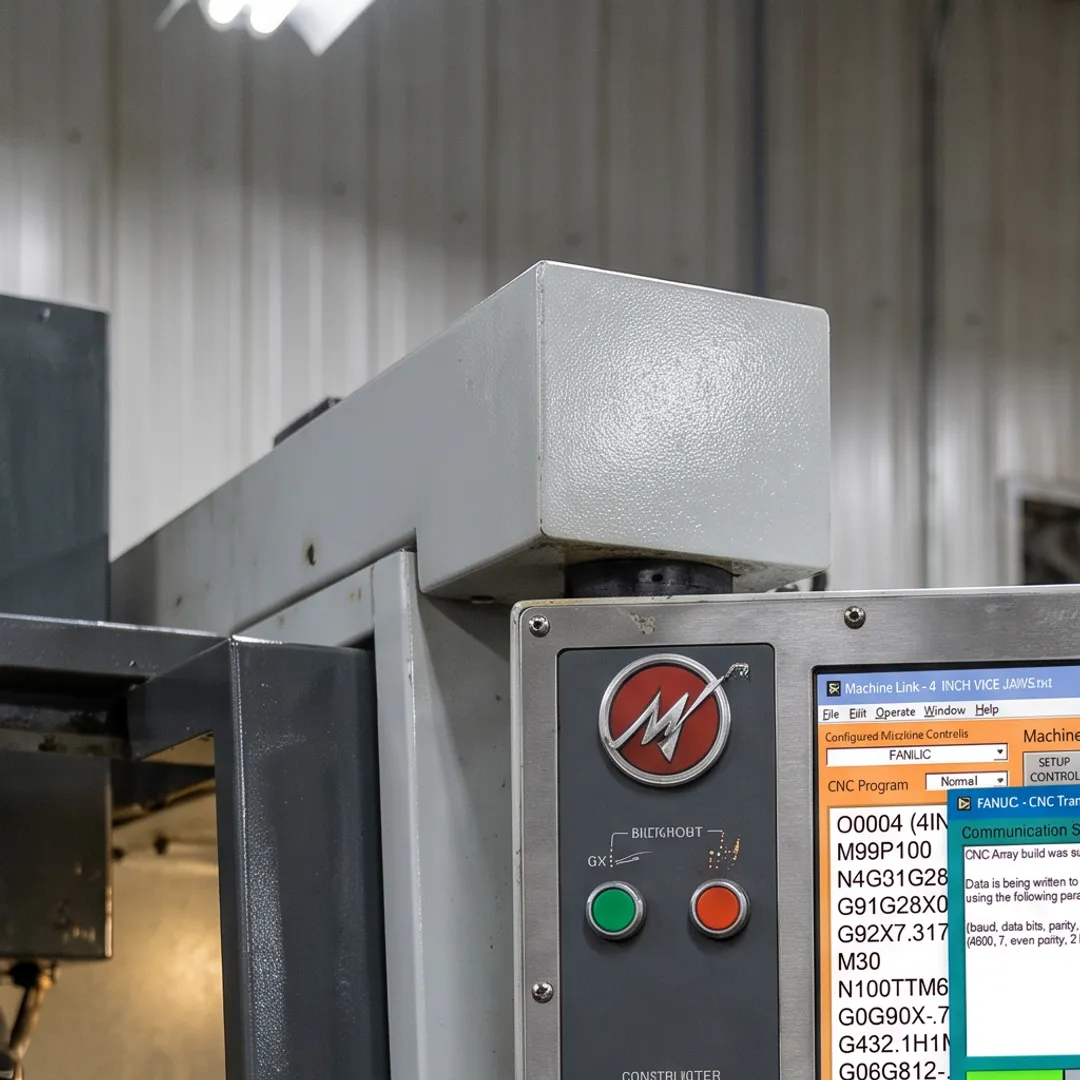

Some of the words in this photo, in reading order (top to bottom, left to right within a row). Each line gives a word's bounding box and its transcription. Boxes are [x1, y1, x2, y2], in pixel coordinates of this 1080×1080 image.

[845, 682, 892, 694] Machine
[896, 679, 919, 693] Link
[929, 681, 935, 692] 4
[942, 680, 971, 691] INCH
[974, 679, 999, 690] VICE
[823, 709, 839, 720] File
[875, 707, 915, 719] Operate
[924, 706, 966, 717] Window
[975, 704, 998, 716] Help
[1039, 757, 1070, 767] SETUP
[941, 776, 977, 786] Normal
[1030, 771, 1080, 782] CONTROL
[828, 780, 854, 792] CNC
[859, 780, 908, 794] Program
[978, 797, 1018, 809] FANUC
[1029, 796, 1054, 807] CNC
[962, 824, 1067, 839] Communication
[838, 841, 932, 860] M99P100
[965, 850, 989, 860] CNC
[992, 850, 1018, 861] Array
[1021, 848, 1045, 858] build
[1048, 850, 1068, 858] was
[838, 868, 948, 888] N4G31G28
[965, 879, 989, 889] Data
[992, 878, 1000, 888] is
[1003, 878, 1030, 890] being
[1033, 877, 1066, 887] written
[1069, 877, 1078, 886] to
[838, 895, 948, 915] G91G28X0
[966, 894, 992, 904] using
[996, 892, 1011, 902] the
[838, 923, 948, 942] G92X7.317
[1001, 922, 1023, 931] data
[1011, 936, 1034, 945] even
[1071, 934, 1076, 944] 2
[838, 952, 881, 970] M30
[838, 978, 948, 997] N100TTM6
[839, 1006, 949, 1025] G0G90X-.7
